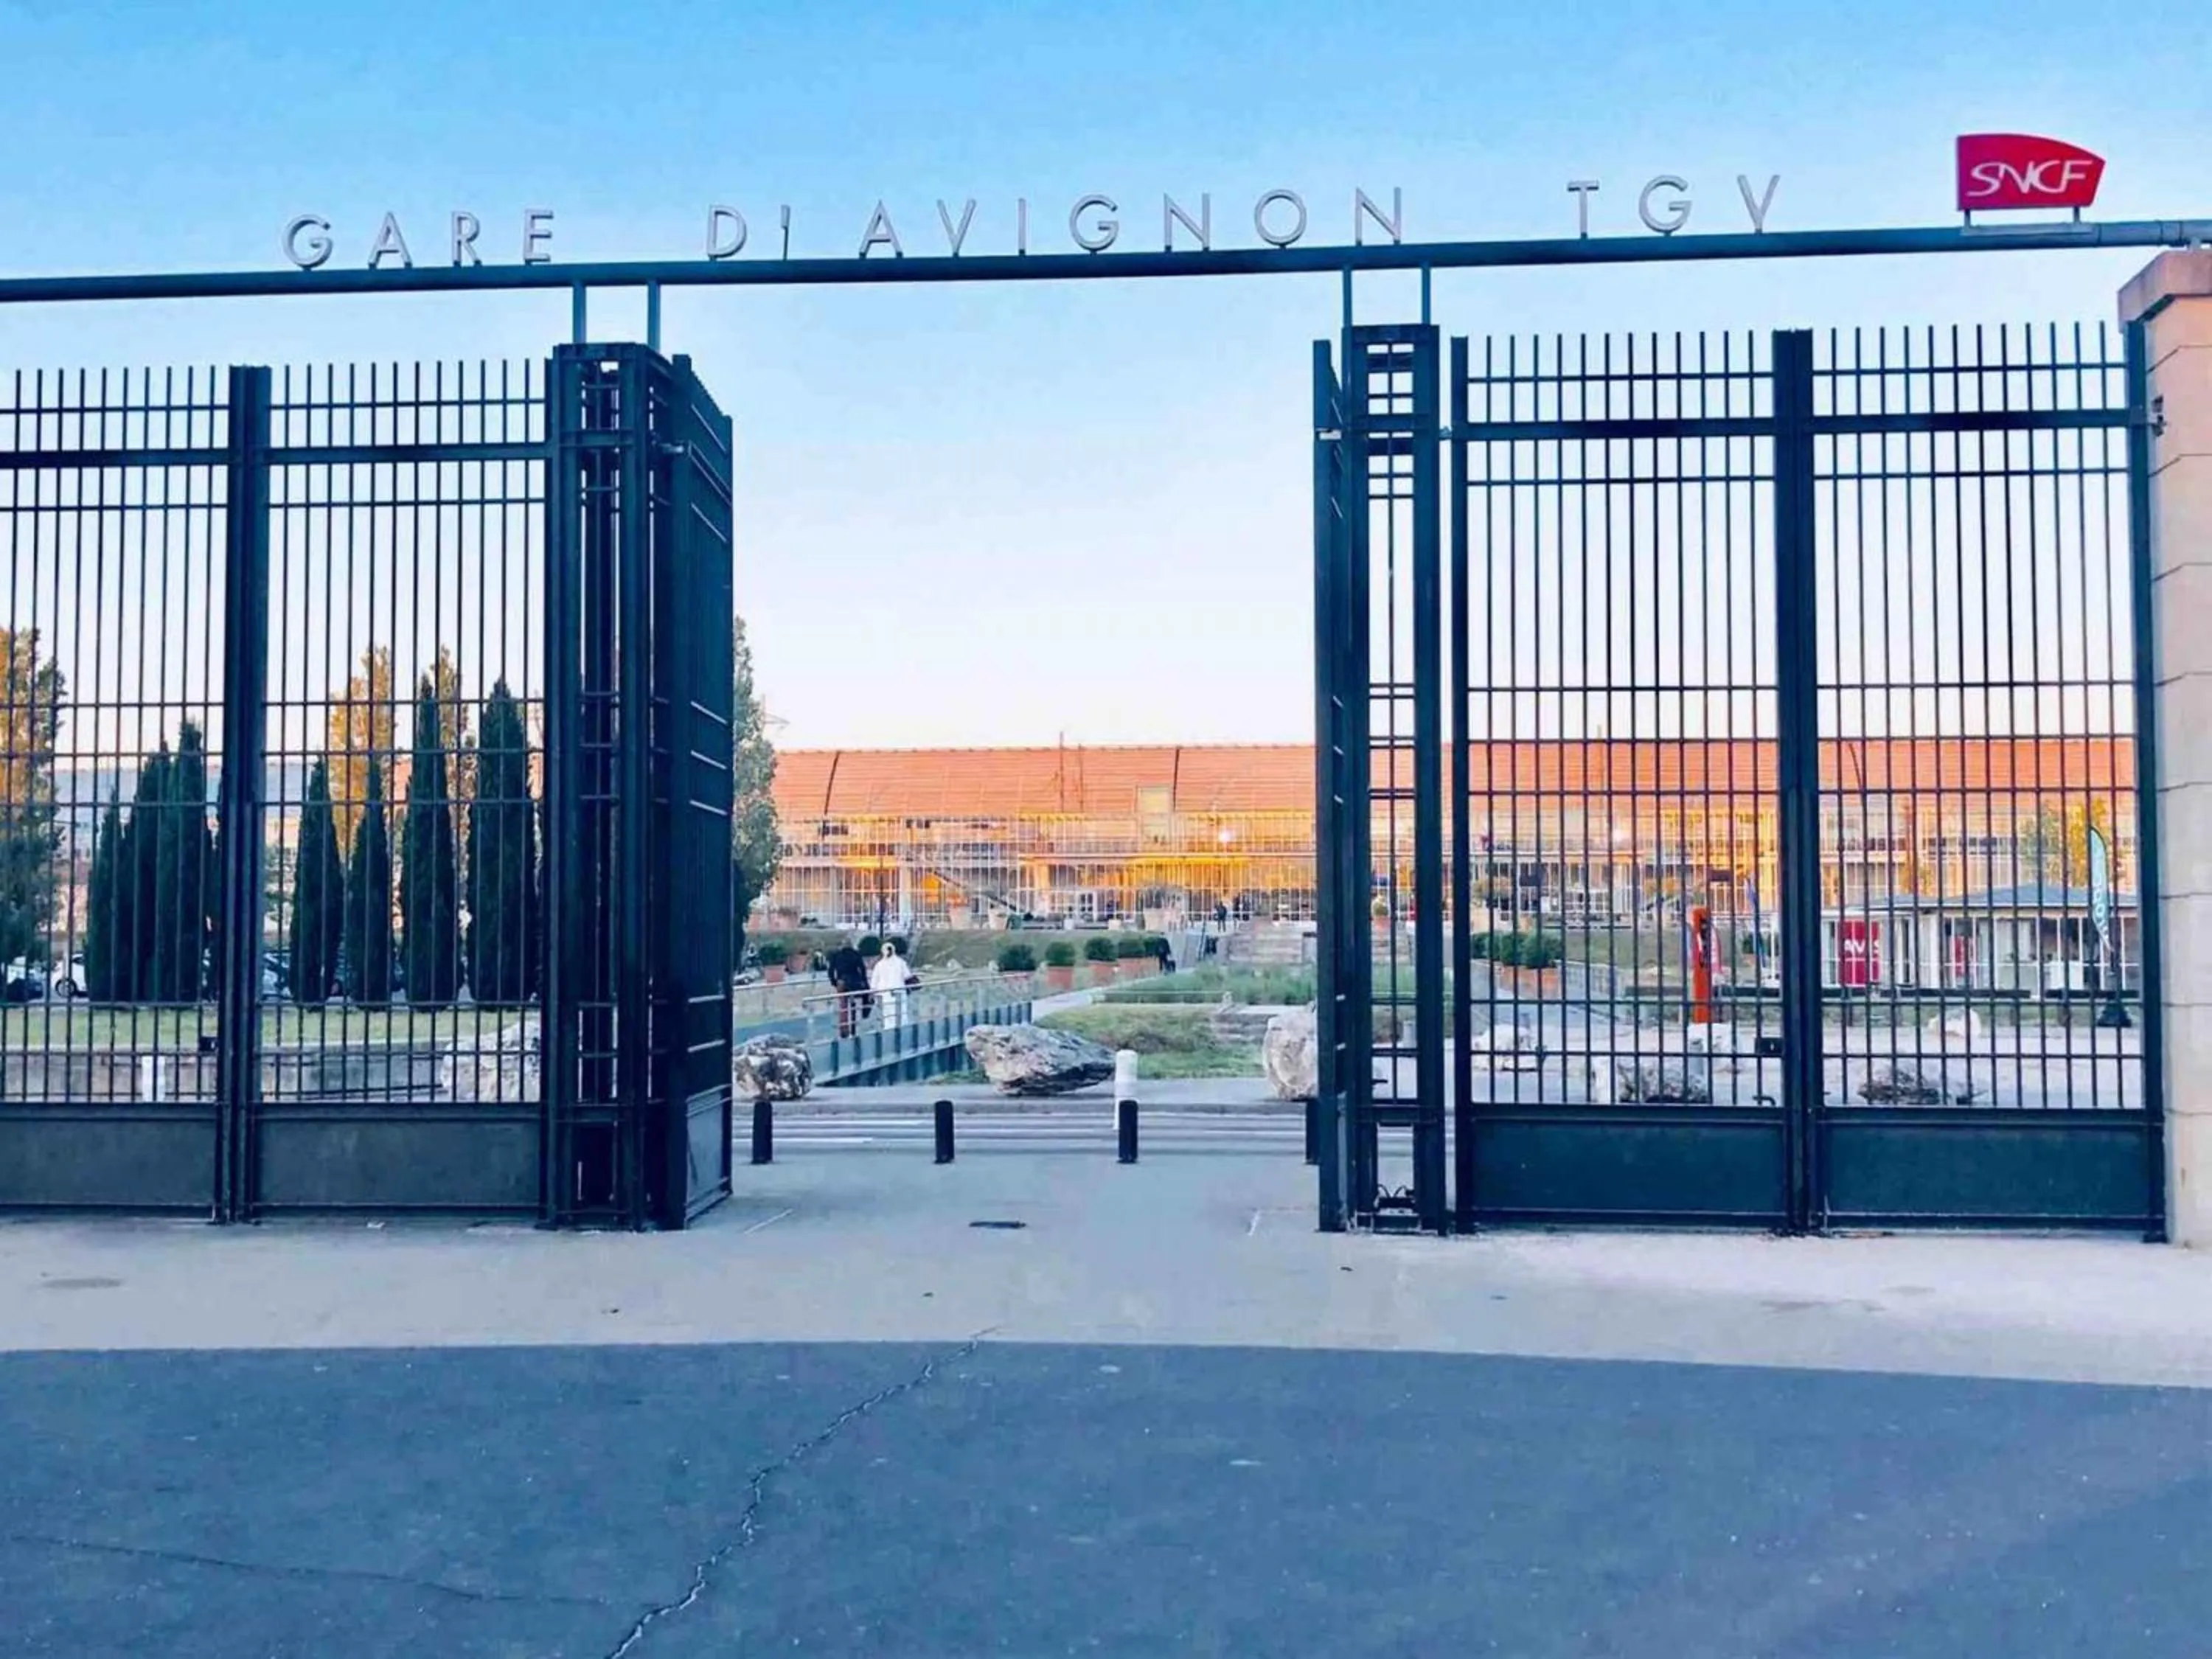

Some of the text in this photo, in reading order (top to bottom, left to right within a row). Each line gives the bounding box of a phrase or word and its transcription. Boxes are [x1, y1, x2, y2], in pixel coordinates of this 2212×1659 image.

[1966, 160, 2093, 197] SNCF
[283, 209, 554, 267] GARE
[1566, 174, 1781, 234] TGV
[1843, 938, 1881, 955] AVS
